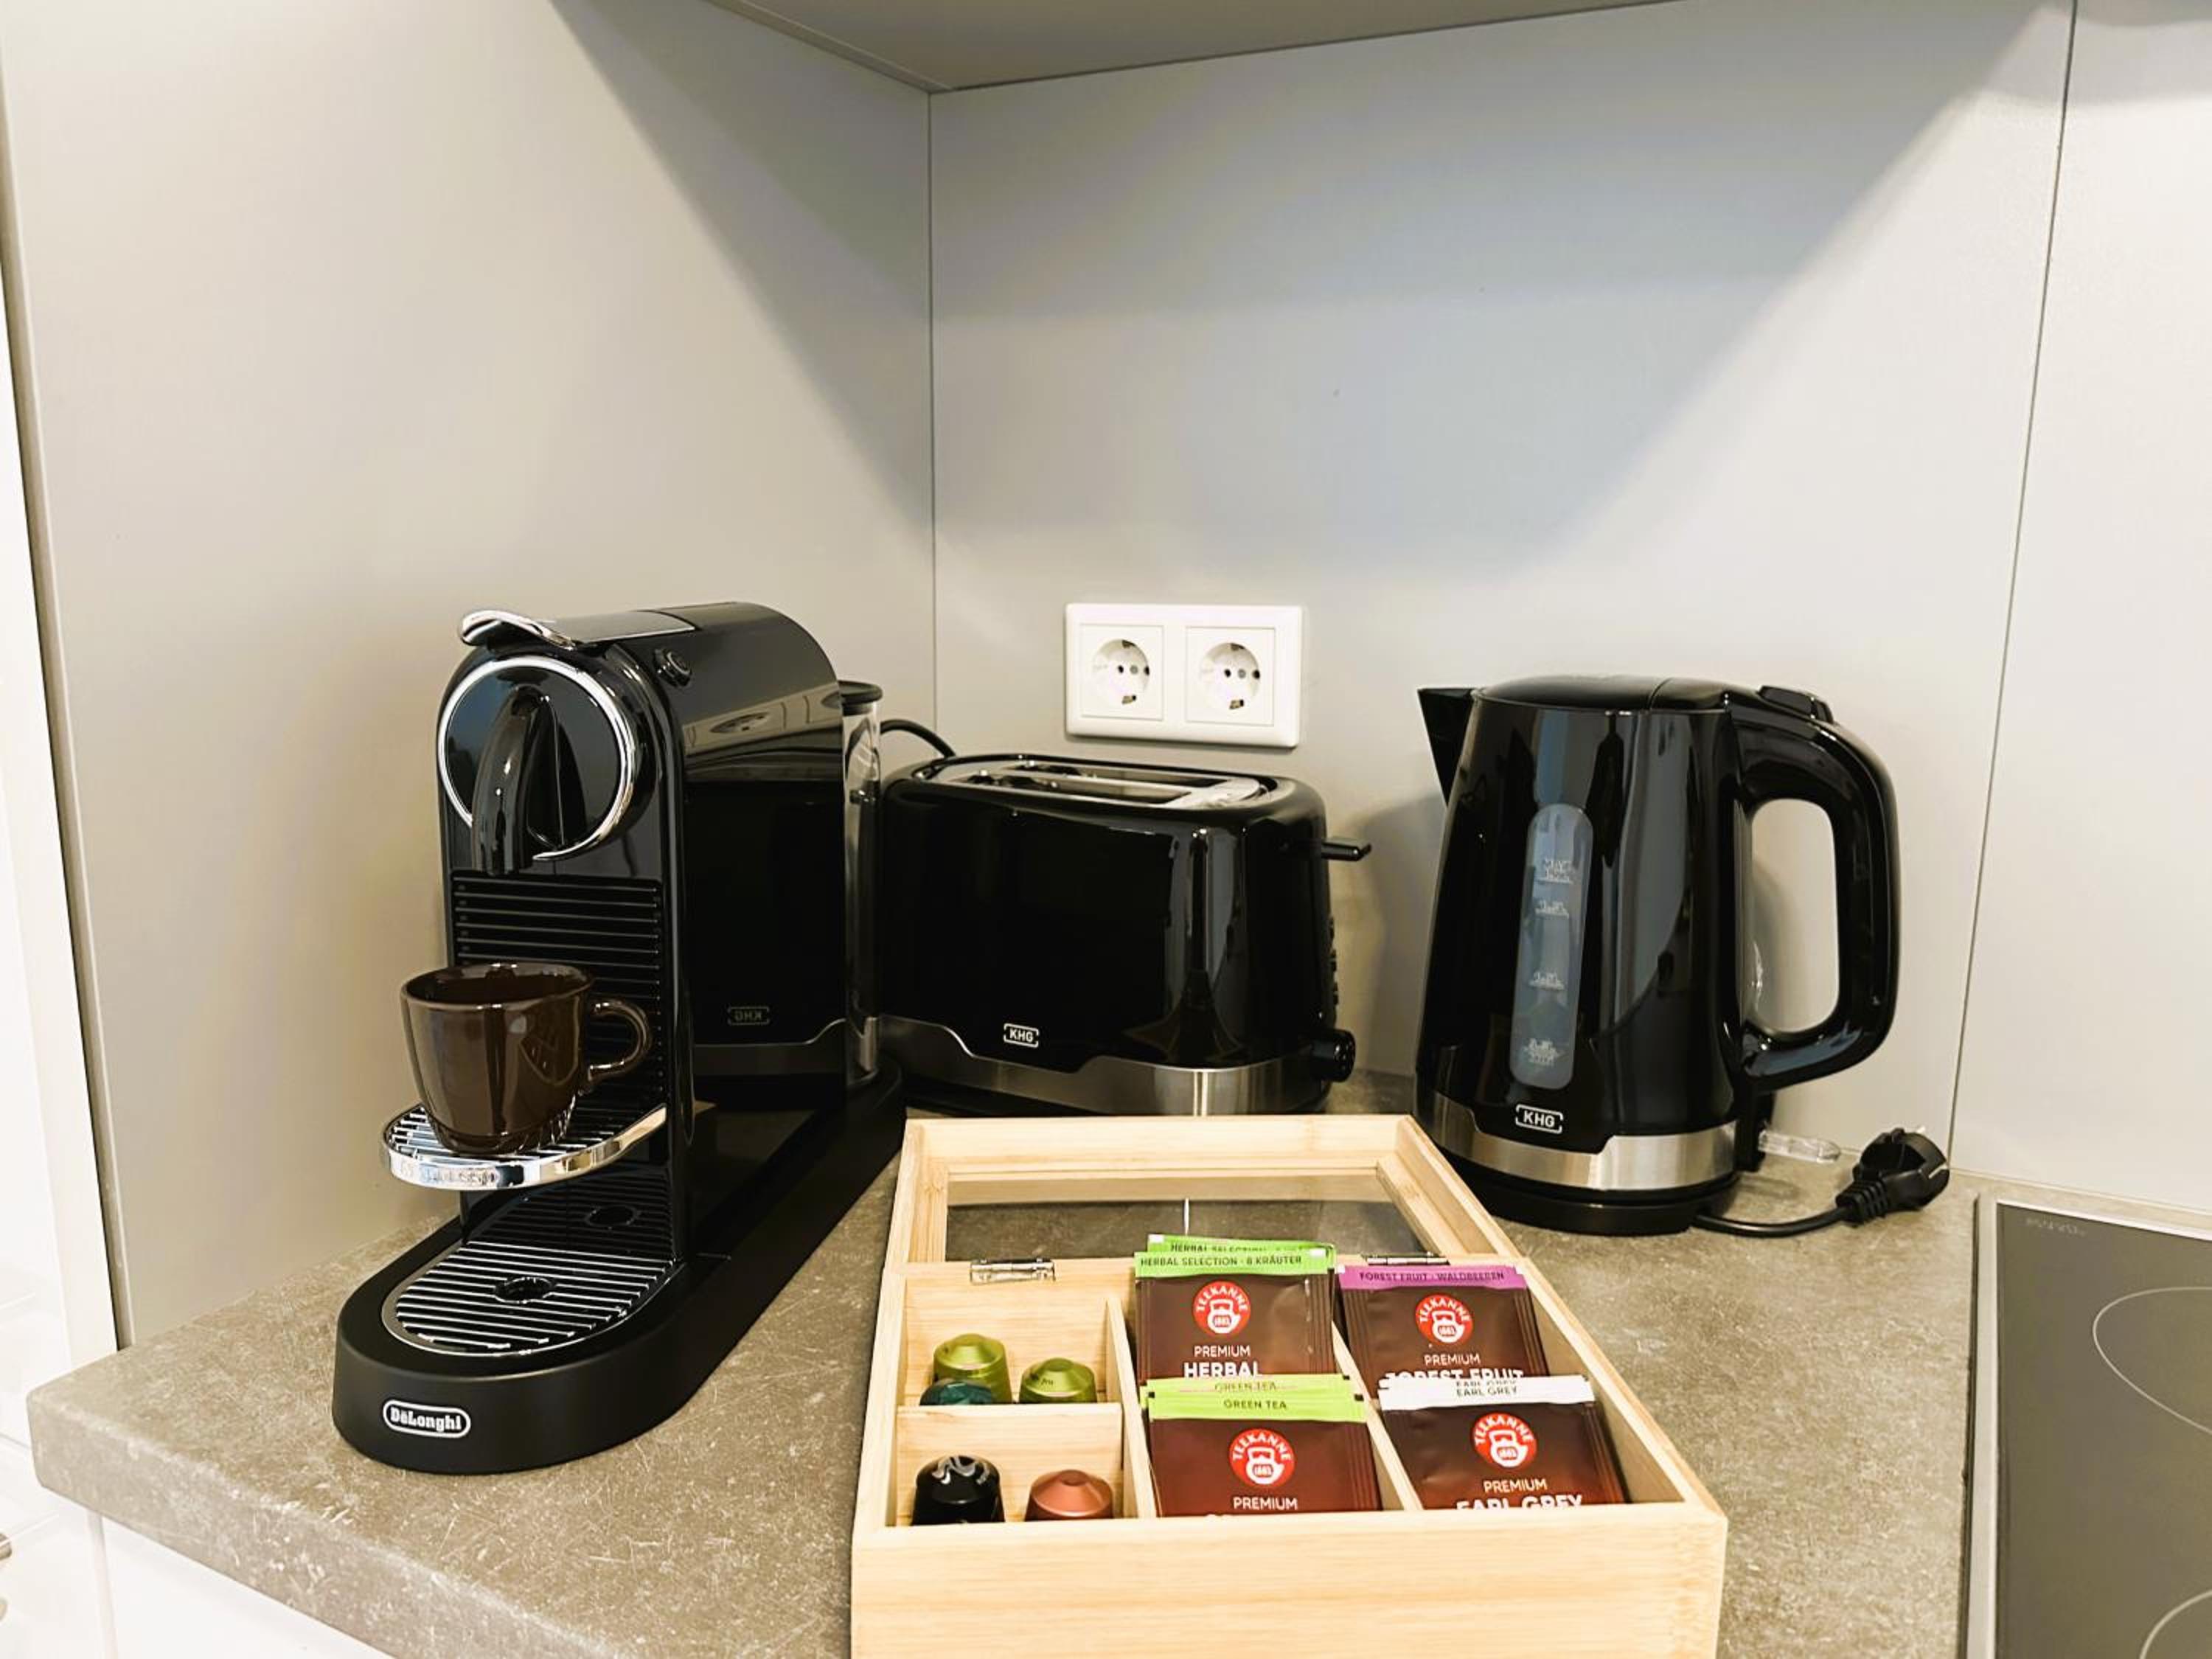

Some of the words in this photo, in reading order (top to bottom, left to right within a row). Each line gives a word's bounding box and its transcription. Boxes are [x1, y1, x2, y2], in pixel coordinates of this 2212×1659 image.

[1009, 1028, 1034, 1043] KHG
[1523, 1110, 1555, 1128] KHG
[1141, 1258, 1180, 1267] HERBAL
[1182, 1258, 1237, 1267] SELECTION
[1256, 1256, 1302, 1265] KRÄUTER
[1360, 1271, 1399, 1281] FOREST
[1400, 1272, 1428, 1281] FRUIT
[1437, 1270, 1505, 1281] WALDBEEREN
[1195, 1285, 1248, 1312] TEEKANNE
[1419, 1297, 1471, 1323] TEEKANNE
[1194, 1344, 1251, 1357] PREMIUM
[1423, 1353, 1481, 1366] PREMIUM
[1183, 1360, 1263, 1378] HERBAL
[1456, 1388, 1485, 1397] EARL
[1486, 1387, 1517, 1396] GREY
[1223, 1399, 1262, 1410] GREEN
[1266, 1400, 1287, 1410] TEA
[1475, 1414, 1534, 1446] TEEKANNE
[1231, 1433, 1292, 1461] TEEKANNE
[1482, 1478, 1548, 1493] PREMIUM
[1232, 1496, 1298, 1511] PREMIUM
